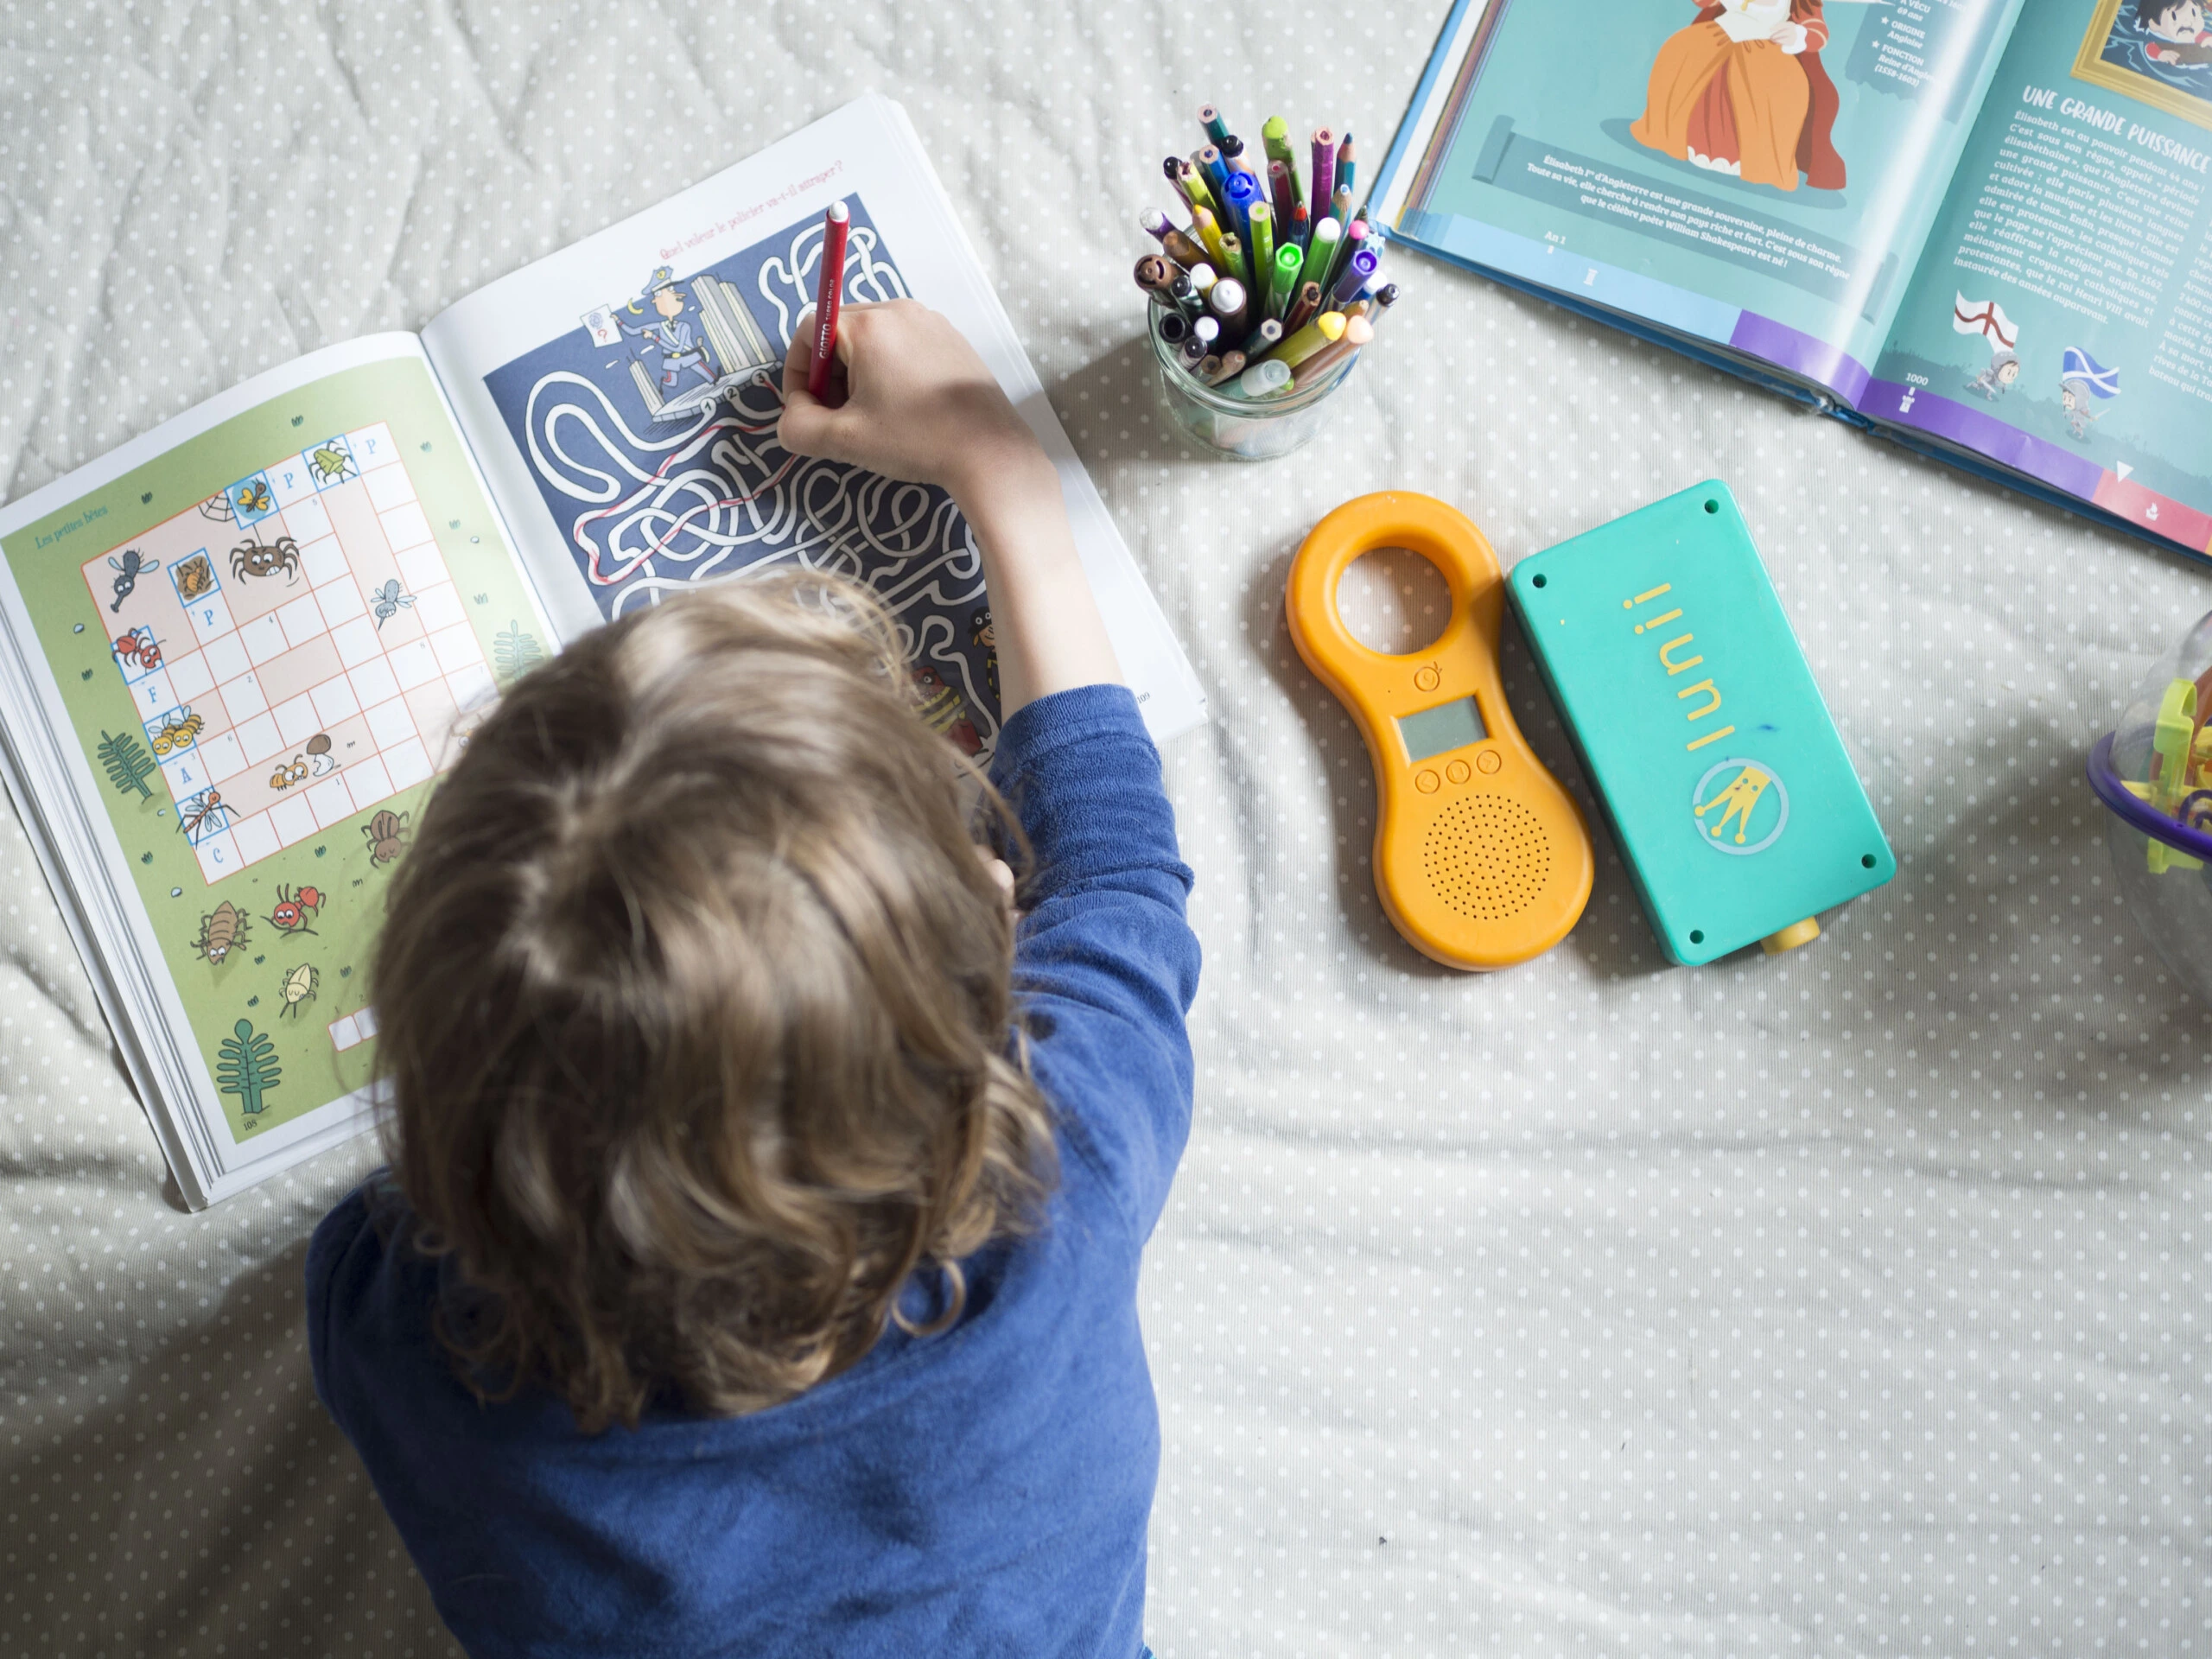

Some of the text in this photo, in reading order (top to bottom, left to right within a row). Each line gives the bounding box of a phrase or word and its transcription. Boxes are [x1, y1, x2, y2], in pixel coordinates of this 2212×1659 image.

[1891, 21, 1925, 39] ORIGINE
[1908, 11, 1923, 22] ans
[1882, 44, 1924, 66] FONCTION
[1887, 30, 1923, 49] Anglaise
[1878, 54, 1901, 68] Reine
[2023, 85, 2211, 174] UNE GRANDE PUISSANCE
[2009, 123, 2200, 206] C'est sous son règne, appelé période
[2014, 110, 2199, 191] Élisabeth est au pouvoir pendant ans
[1999, 149, 2018, 159] une
[2021, 155, 2058, 172] grande
[2060, 168, 2111, 194] puissance.
[2116, 190, 2139, 207] C'est
[2143, 204, 2161, 217] une
[2164, 213, 2190, 230] reine
[2004, 135, 2194, 218] élisabéthaine que l'Angleterre devient
[659, 160, 843, 260] Quel voleur le policier attraper ?
[1527, 162, 1824, 269] Toute sa vie, elle cherche à rendre son pays riche et fort. C'est sous son
[1543, 154, 1840, 263] Élisabeth d'Angleterre est une grande souveraine, pleine de charme.
[1989, 173, 2179, 254] et adore la musique et les livres. Elle est
[1993, 161, 2184, 242] cultivée elle parle plusieurs langues
[1544, 231, 1566, 245] An 1
[1580, 194, 1788, 267] que le célèbre poète William Shakespeare est né!
[1979, 196, 2149, 270] elle est protestante, les catholiques
[1984, 185, 2174, 266] admirée de tous... Enfin, presque! Comme
[1963, 233, 2139, 308] mélangeant croyances catholiques
[1968, 220, 2158, 304] elle réaffirme la religion anglicane,
[1974, 209, 2162, 292] que le pape ne l'apprécient pas. En 1562,
[1953, 256, 2108, 324] instaurée des années auparavant.
[1957, 245, 2149, 327] protestantes, que le roi Henri VIII avait
[597, 328, 608, 342] ?
[819, 323, 831, 359] GIOTTO
[728, 389, 736, 397] 2
[758, 372, 766, 383] 3
[1906, 372, 1929, 385] 1000
[704, 401, 710, 410] 1
[367, 437, 377, 454] P
[283, 472, 295, 490] P
[35, 505, 108, 550] Les petites bêtes
[203, 610, 215, 626] P
[1623, 582, 1735, 752] lunii
[148, 686, 158, 703] F
[1136, 691, 1150, 704] 109
[181, 767, 193, 784] A
[213, 849, 223, 864] C
[243, 1119, 257, 1131] 108
